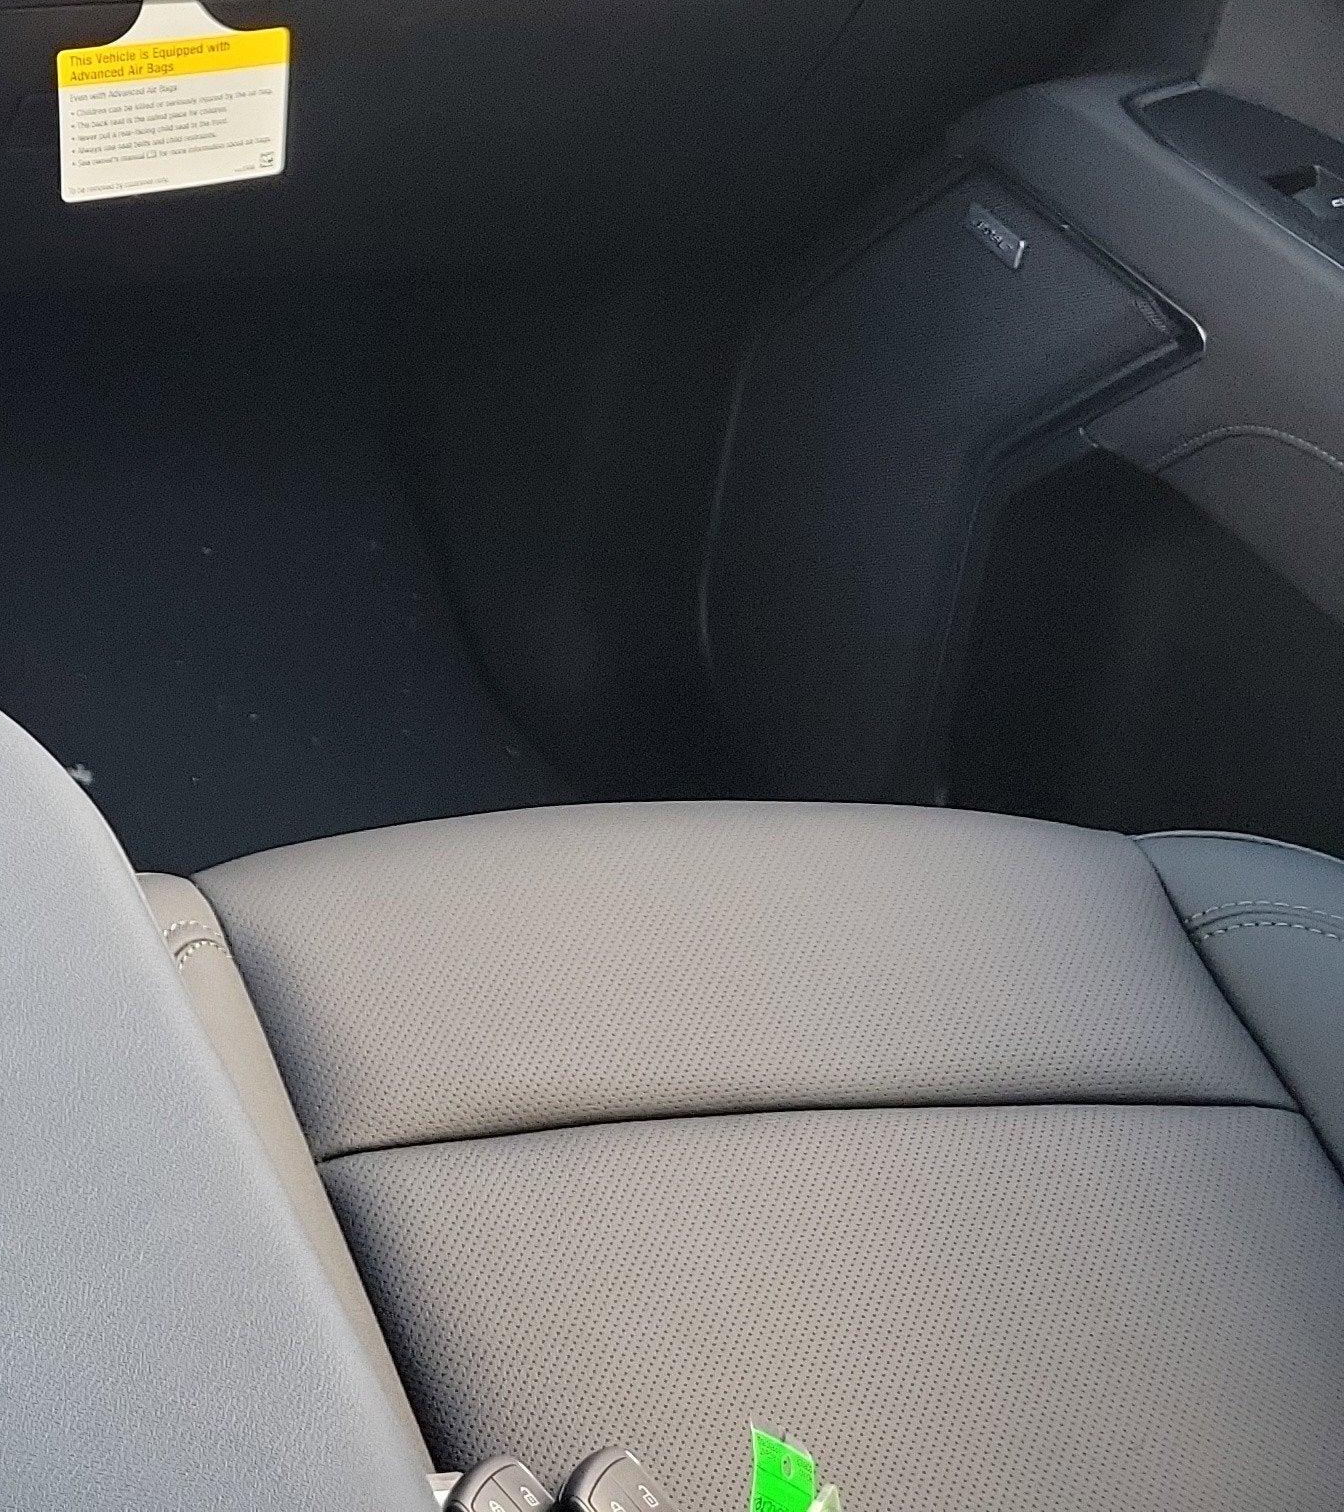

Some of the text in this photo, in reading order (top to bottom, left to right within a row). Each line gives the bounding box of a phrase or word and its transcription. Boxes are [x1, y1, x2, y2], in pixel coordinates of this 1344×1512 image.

[69, 41, 230, 67] This Vehicle is Equipped with
[70, 61, 174, 82] Advanced Air Bags
